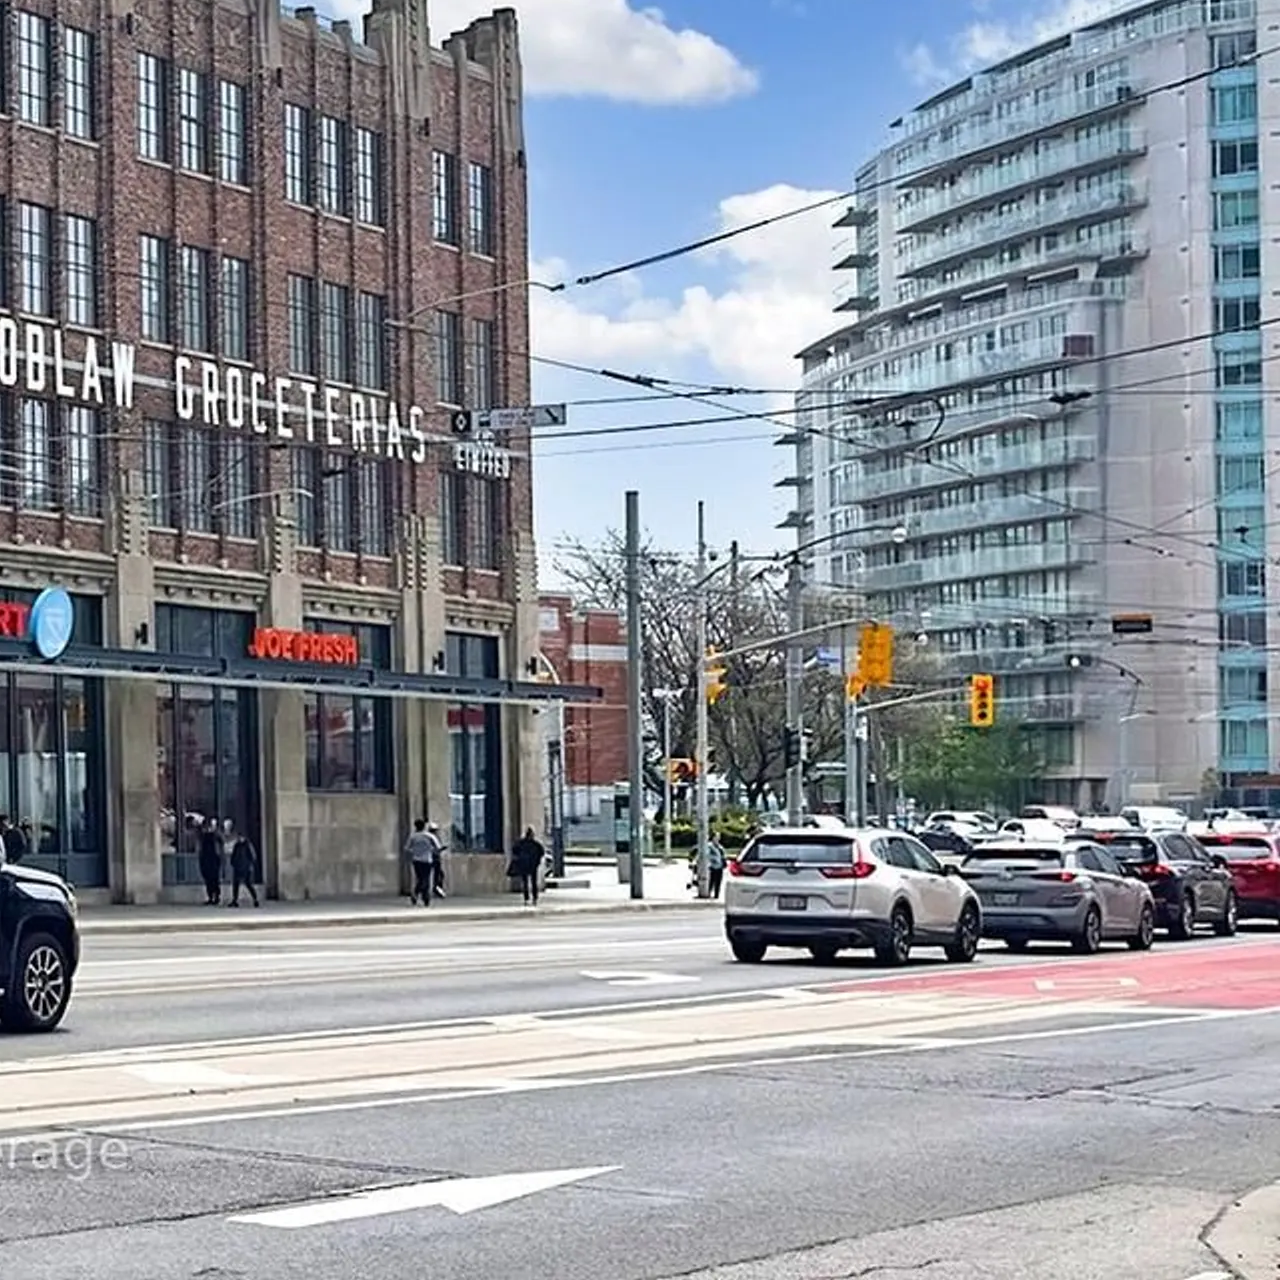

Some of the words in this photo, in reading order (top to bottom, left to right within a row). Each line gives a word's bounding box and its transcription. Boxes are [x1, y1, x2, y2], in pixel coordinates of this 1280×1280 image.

[175, 355, 426, 464] GROCETERIAS
[248, 627, 298, 661] JOE
[299, 631, 360, 665] FRESH
